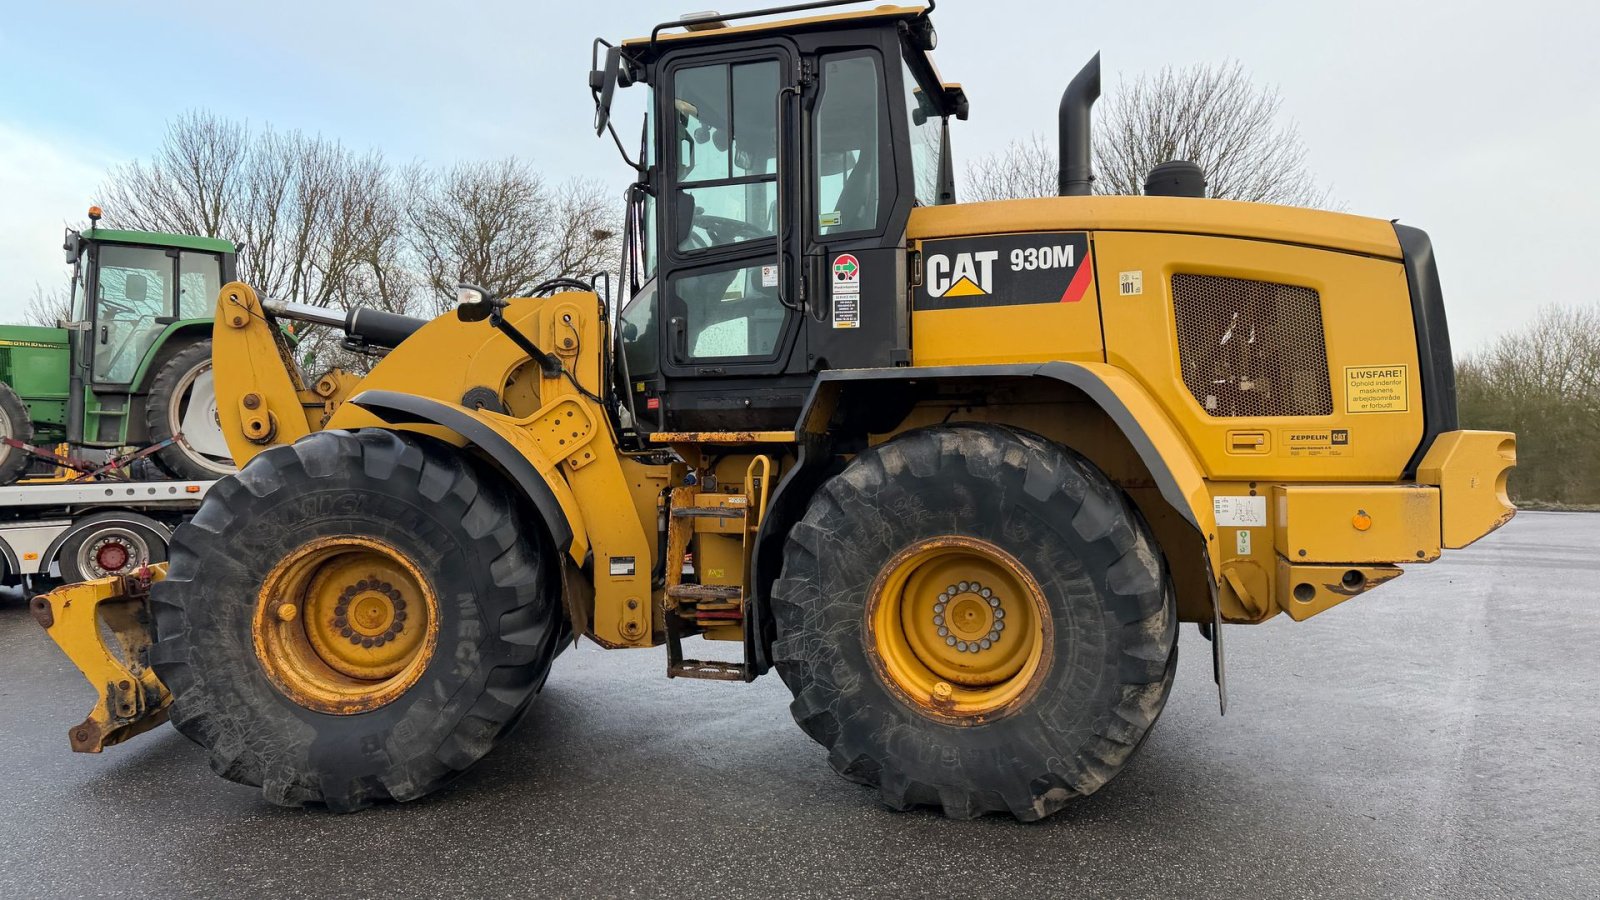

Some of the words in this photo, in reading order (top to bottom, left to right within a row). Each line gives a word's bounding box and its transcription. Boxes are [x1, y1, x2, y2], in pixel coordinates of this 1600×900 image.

[1010, 244, 1074, 272] 930M
[927, 250, 998, 298] CAT
[1121, 281, 1134, 294] 101
[1350, 370, 1402, 379] LIVSFARE!
[1350, 380, 1374, 388] Ophold
[1332, 433, 1347, 441] CAT
